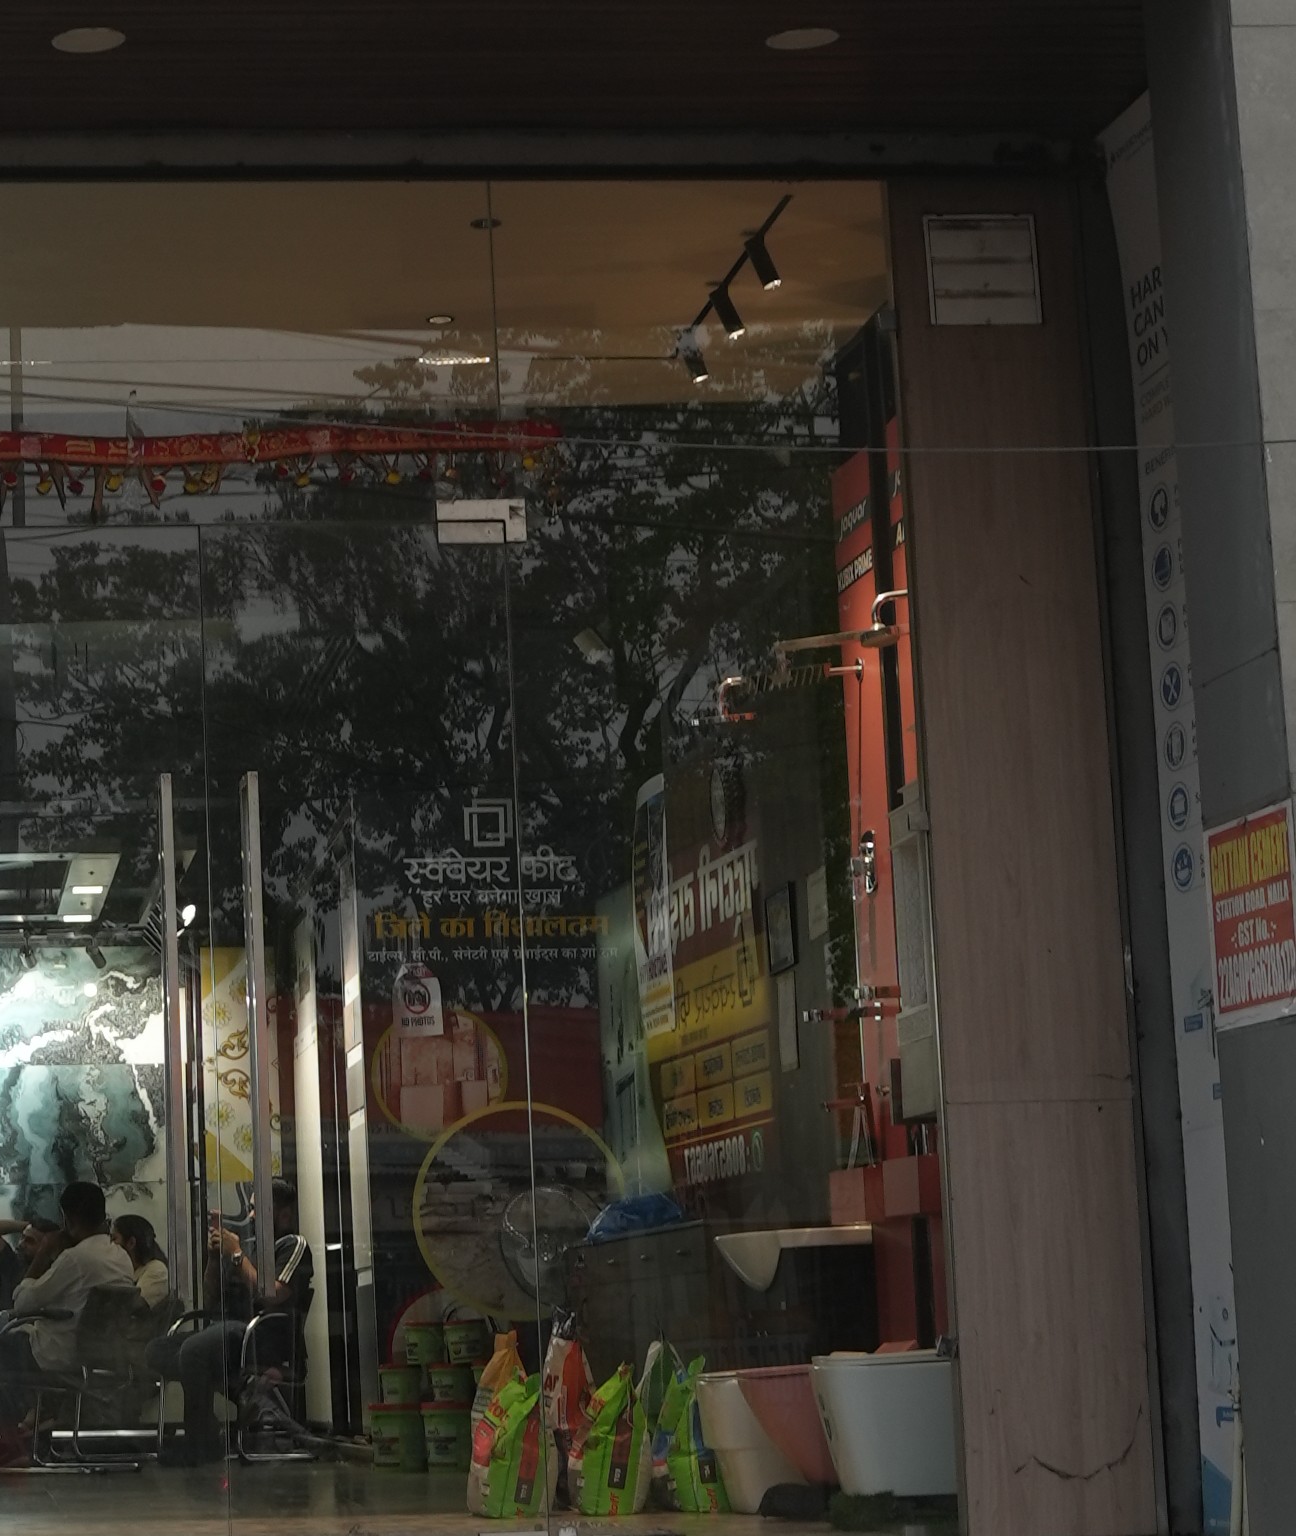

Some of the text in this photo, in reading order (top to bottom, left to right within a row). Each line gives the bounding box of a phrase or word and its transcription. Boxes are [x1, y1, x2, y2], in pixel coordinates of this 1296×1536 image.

[402, 845, 578, 885] स्क्वेयर फीट
[1250, 822, 1289, 883] CEMENT
[1215, 892, 1245, 923] STATION
[374, 910, 431, 939] जिले
[439, 914, 475, 939] का
[561, 947, 577, 959] का
[410, 1015, 436, 1027] PHOTOS
